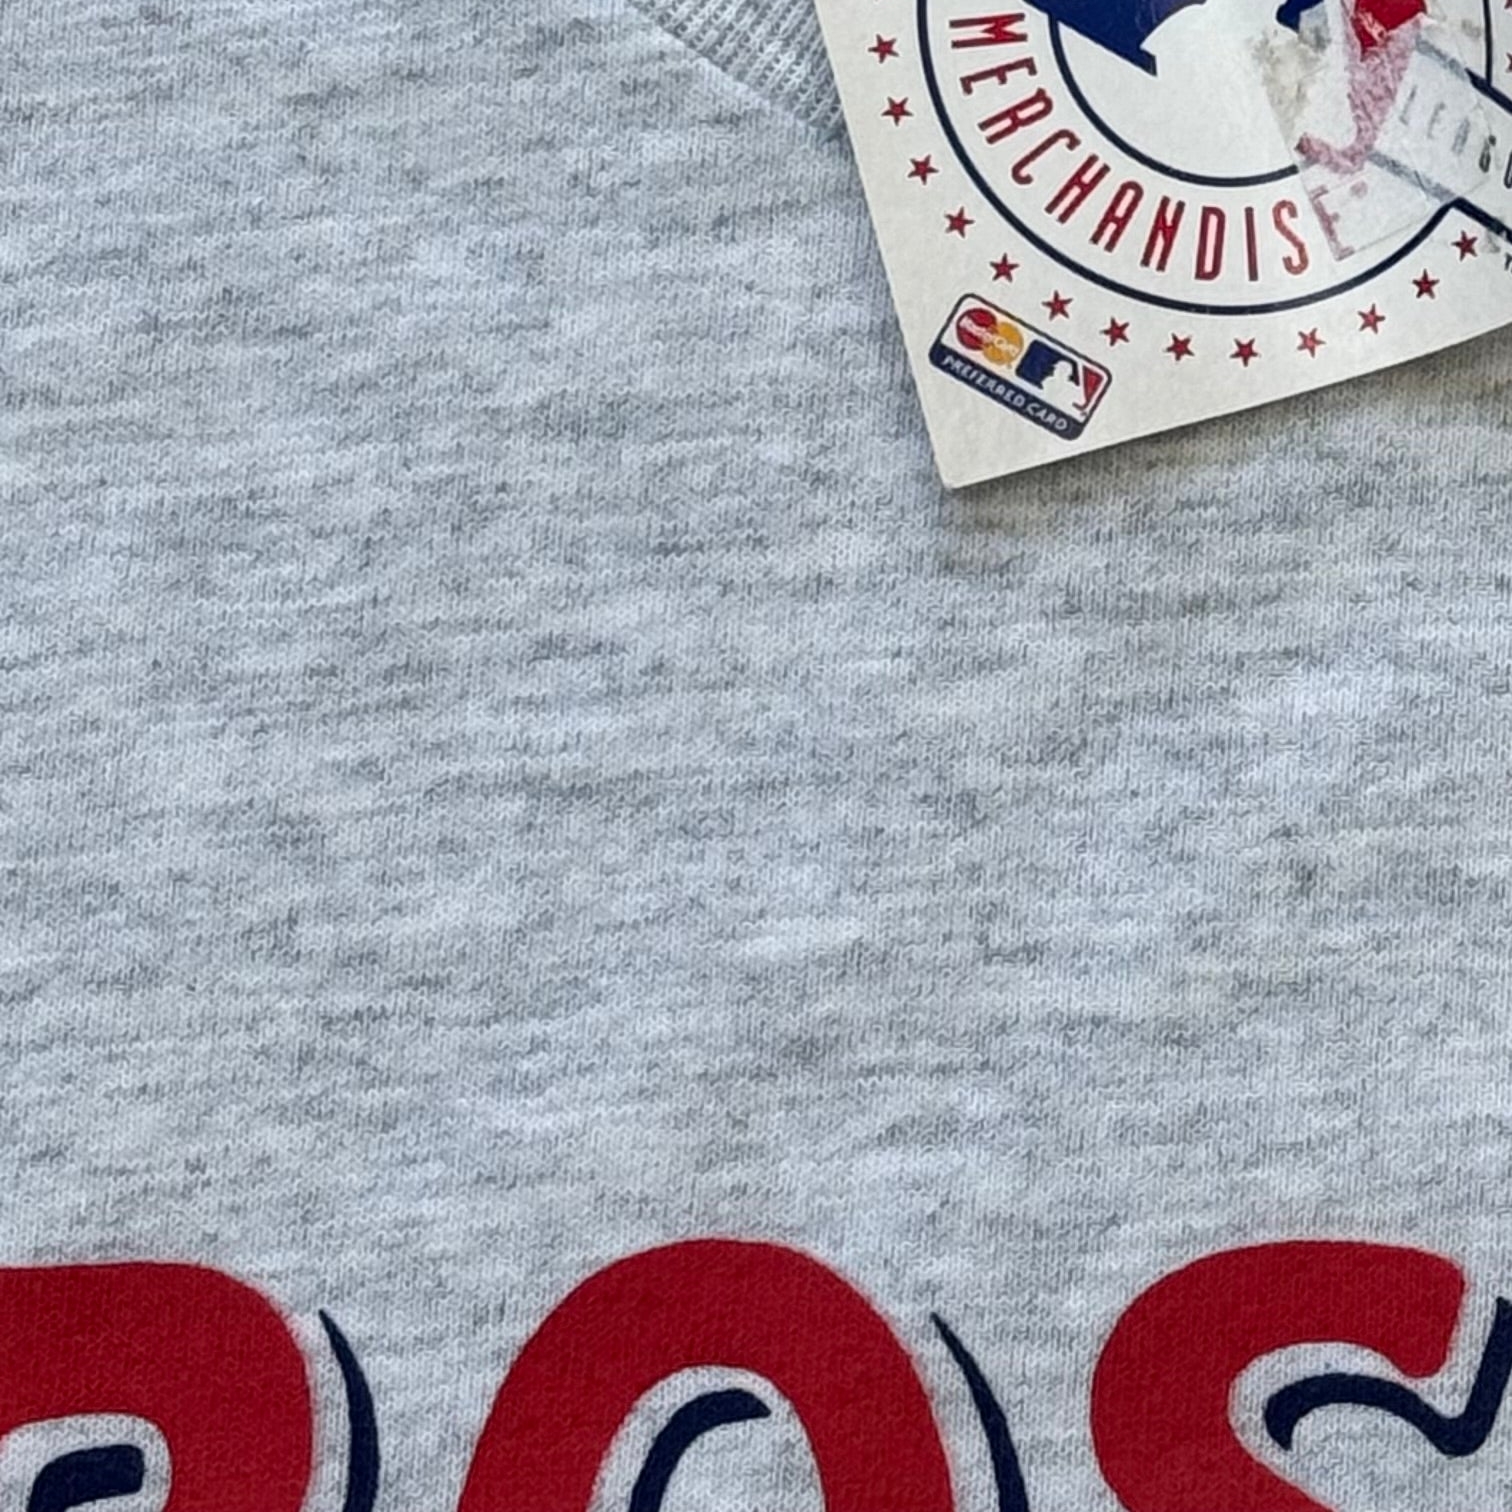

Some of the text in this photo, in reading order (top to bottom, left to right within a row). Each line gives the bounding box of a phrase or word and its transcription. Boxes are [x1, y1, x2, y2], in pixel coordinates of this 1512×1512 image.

[948, 12, 1355, 281] MERCHANDISE
[941, 355, 1069, 431] PREFERRED CARD
